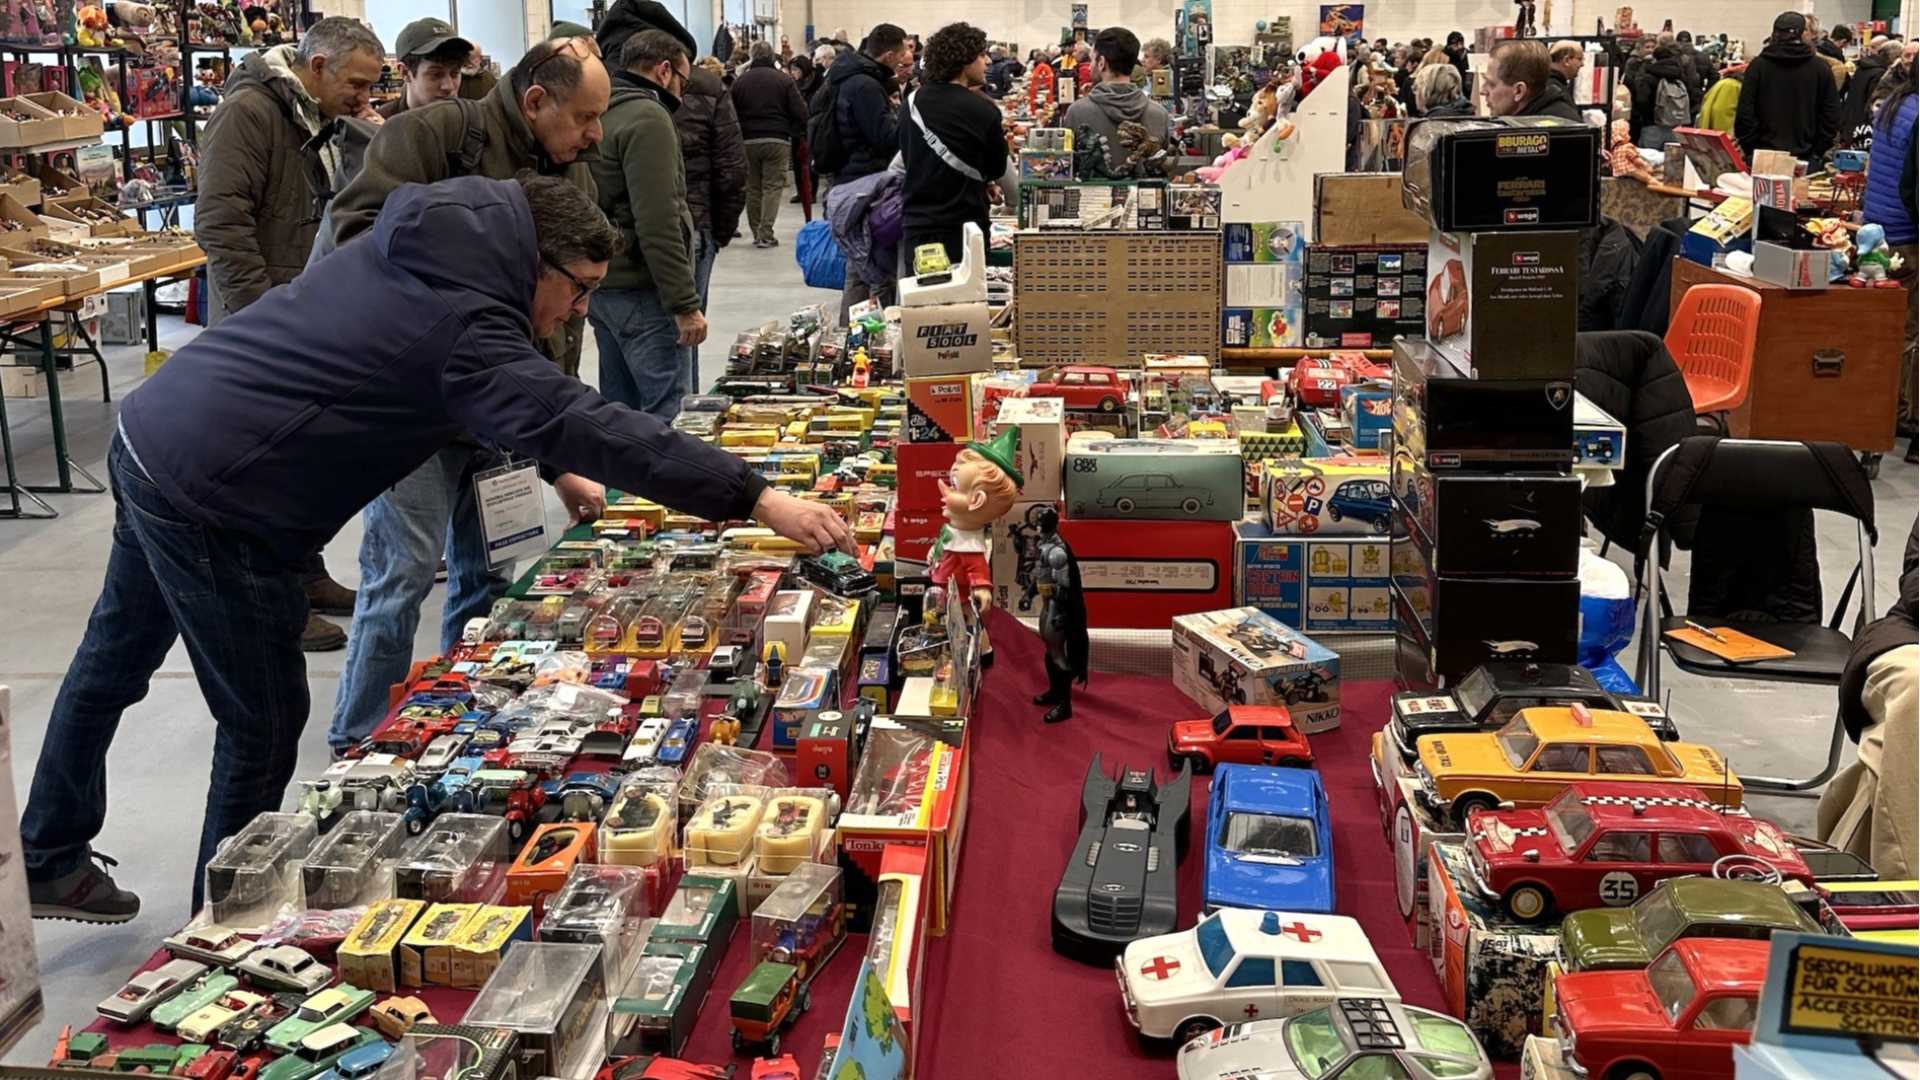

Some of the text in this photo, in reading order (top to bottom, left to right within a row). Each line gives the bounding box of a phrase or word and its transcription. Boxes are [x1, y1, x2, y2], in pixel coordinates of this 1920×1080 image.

[1499, 135, 1547, 146] BBURAGO
[919, 324, 967, 337] FIAT
[928, 335, 977, 349] 500L
[909, 427, 939, 440] 1:24
[1305, 707, 1339, 725] NIKKO
[1603, 879, 1635, 900] 35
[1801, 974, 1838, 992] FÜR
